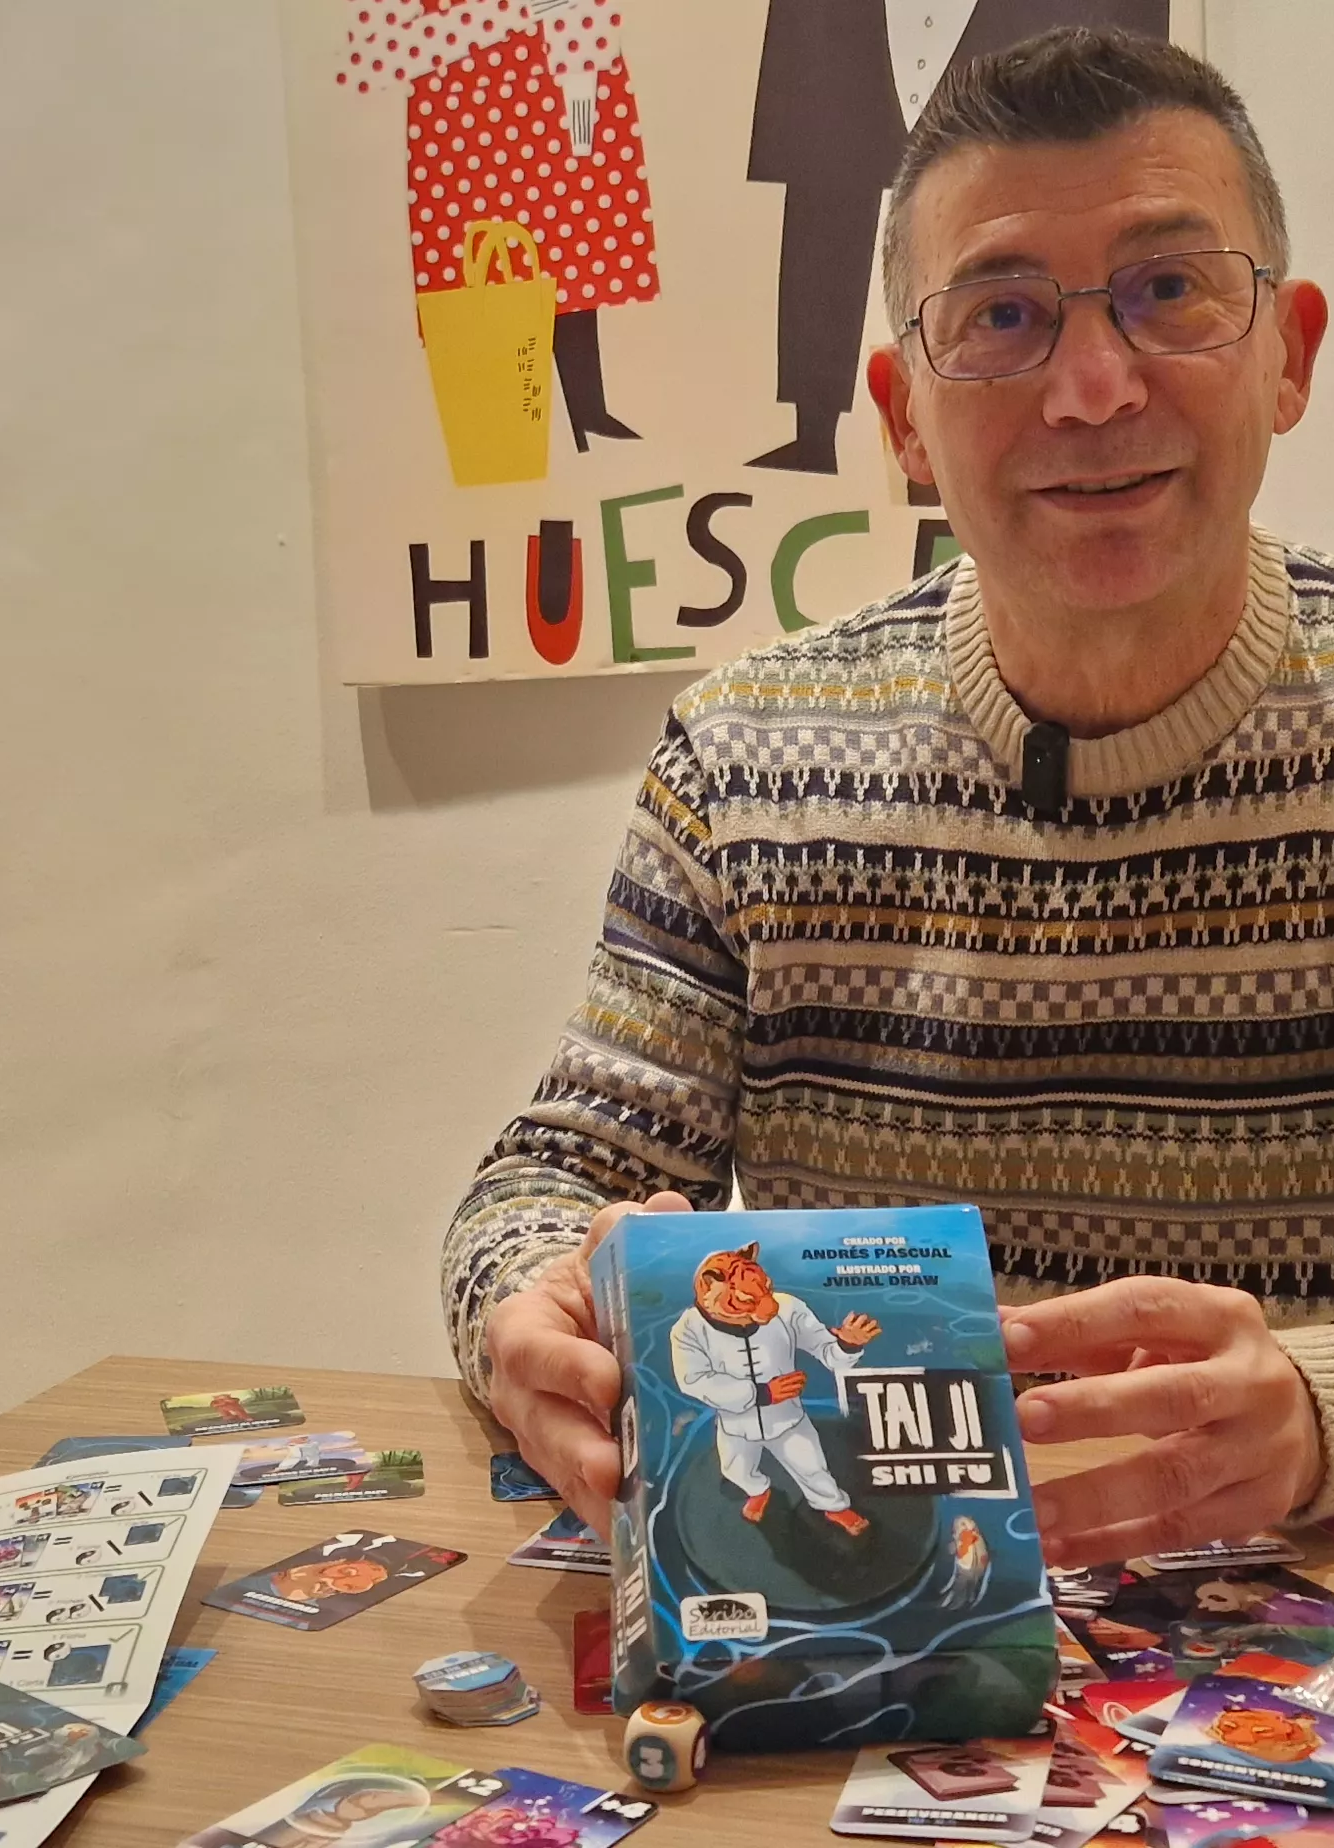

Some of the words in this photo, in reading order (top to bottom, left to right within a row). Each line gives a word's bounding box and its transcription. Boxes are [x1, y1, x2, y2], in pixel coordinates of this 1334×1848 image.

[409, 484, 967, 665] HUESC
[843, 1237, 884, 1245] CREADO
[885, 1236, 906, 1245] POR
[801, 1246, 870, 1260] ANDRÉS
[875, 1248, 952, 1259] PASCUAL
[836, 1265, 898, 1274] ILUSTRADO
[898, 1264, 921, 1273] POR
[822, 1275, 884, 1287] JVIDAL
[889, 1275, 939, 1286] DRAW
[856, 1382, 934, 1451] TAI
[948, 1379, 984, 1450] JI
[871, 1464, 937, 1486] SHI
[946, 1463, 992, 1484] FU
[689, 1603, 755, 1624] Scribo
[689, 1622, 761, 1636] Editorial
